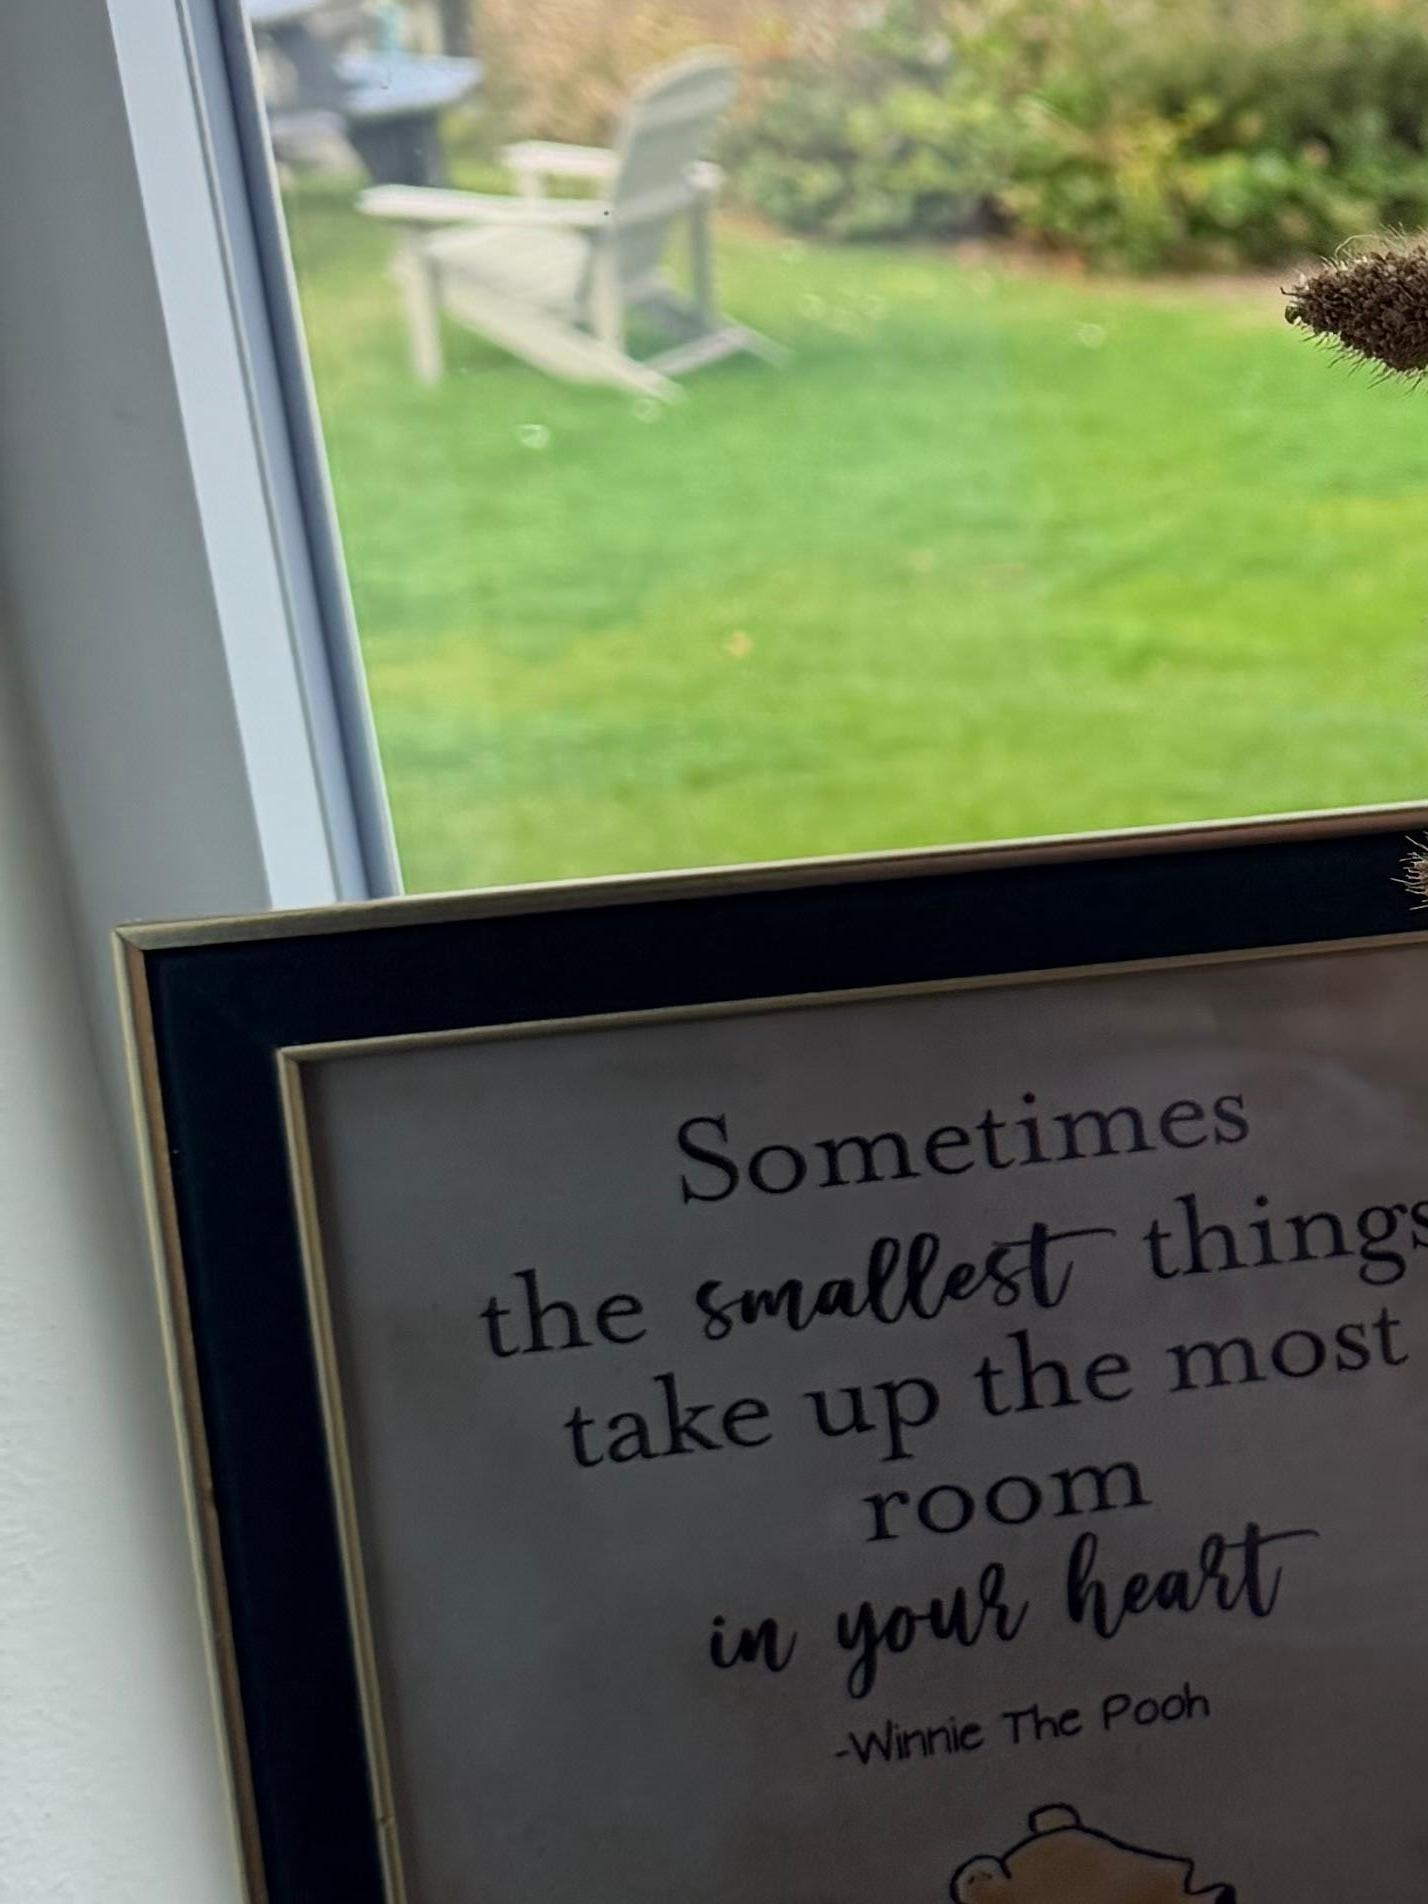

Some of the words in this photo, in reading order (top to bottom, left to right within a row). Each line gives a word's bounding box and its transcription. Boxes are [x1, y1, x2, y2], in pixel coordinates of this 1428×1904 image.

[676, 1091, 1249, 1205] Sometimes
[478, 1267, 647, 1359] the
[694, 1221, 1117, 1342] smallest
[563, 1371, 773, 1468] take
[802, 1377, 940, 1463] up
[972, 1328, 1133, 1417] the
[1165, 1306, 1410, 1394] most
[861, 1461, 1153, 1543] room
[709, 1614, 798, 1674] in
[836, 1561, 1030, 1701] your
[1065, 1521, 1321, 1641] heart
[834, 1715, 985, 1766] -Winnie
[999, 1703, 1084, 1745] The
[1101, 1681, 1211, 1732] Pooh
